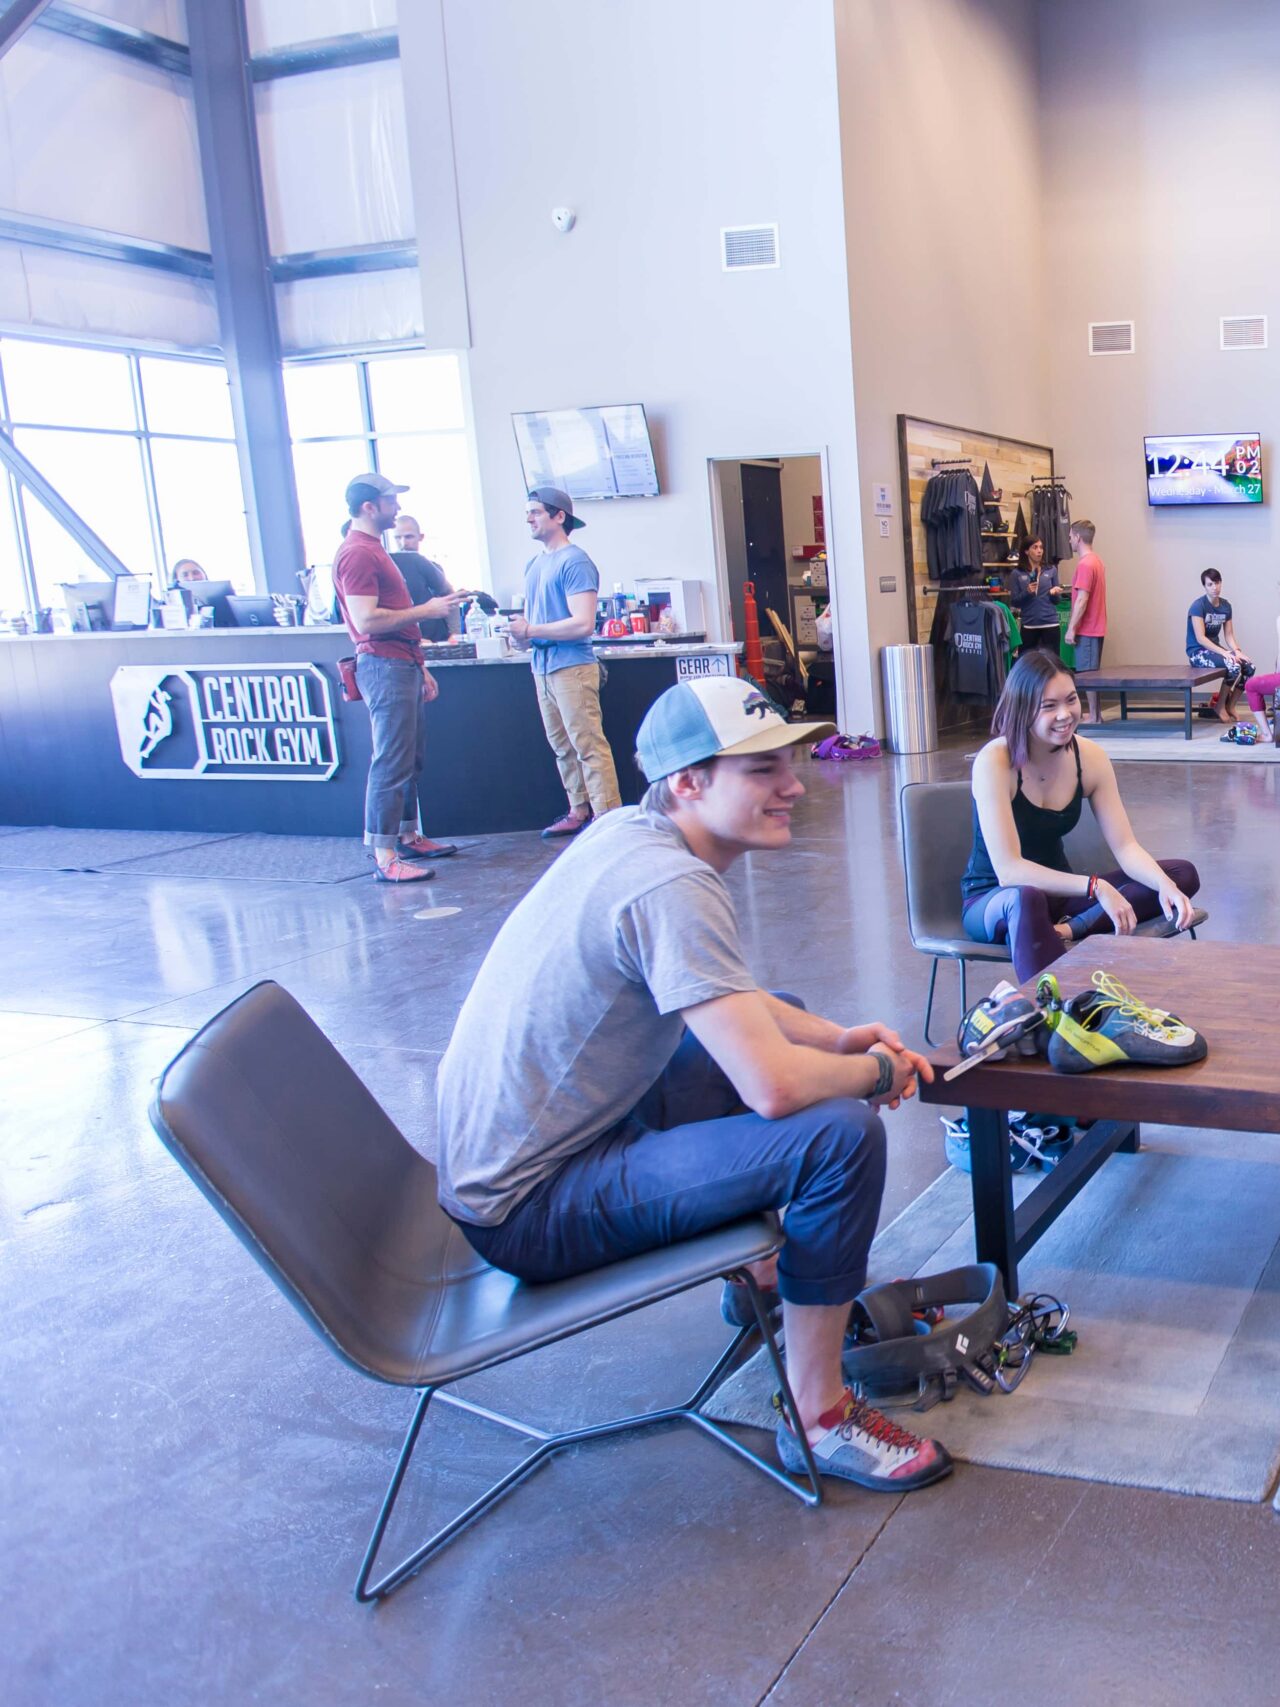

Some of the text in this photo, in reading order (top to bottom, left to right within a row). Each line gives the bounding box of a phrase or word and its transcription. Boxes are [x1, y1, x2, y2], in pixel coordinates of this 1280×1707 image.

[1147, 446, 1261, 478] 12:44 PM
[1151, 486, 1207, 497] Wednesday
[1214, 484, 1246, 494] Mch
[1247, 483, 1261, 494] 27
[678, 657, 711, 675] GEAR
[202, 675, 317, 722] CENTRAL
[209, 727, 322, 765] ROCK GYM
